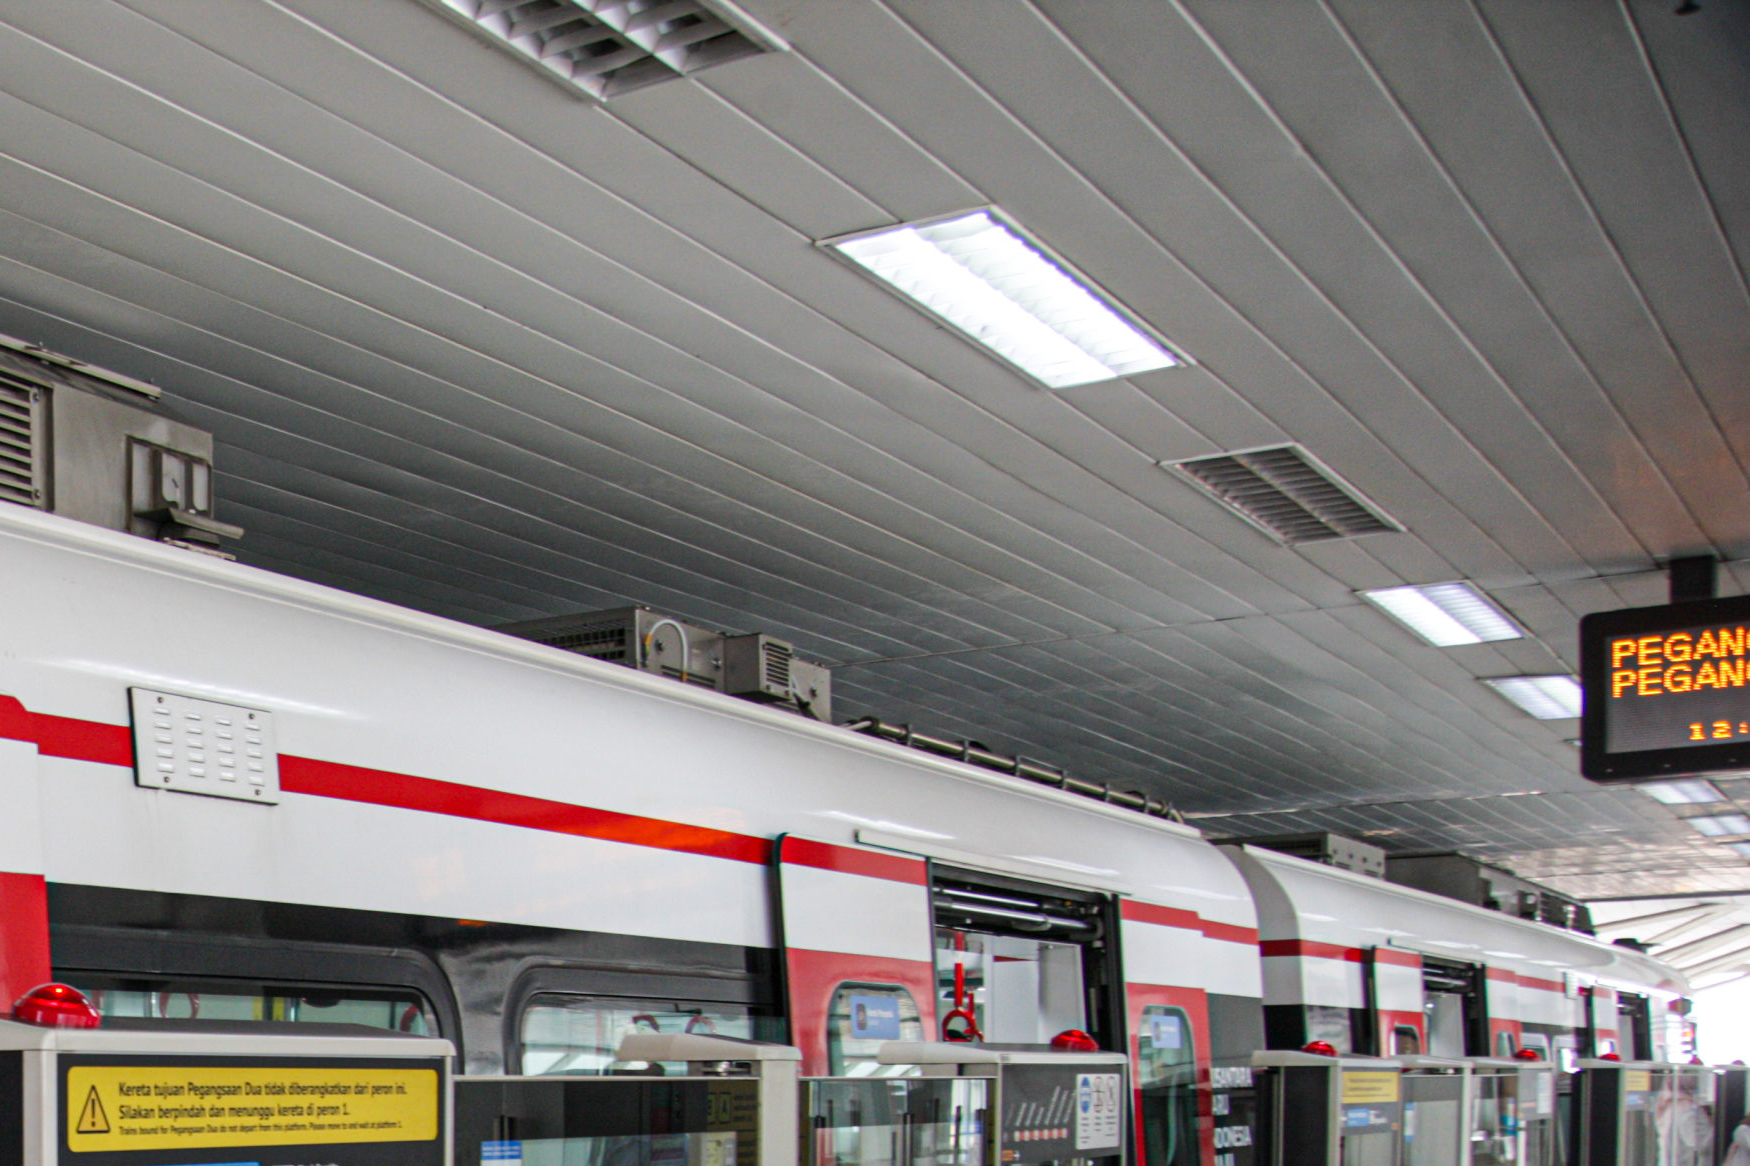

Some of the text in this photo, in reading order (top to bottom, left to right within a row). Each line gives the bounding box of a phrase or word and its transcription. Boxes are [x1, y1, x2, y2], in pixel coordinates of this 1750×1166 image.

[1612, 626, 1750, 668] PEGAN
[1612, 658, 1750, 698] PEGAN
[119, 1082, 150, 1096] Kereta
[154, 1083, 185, 1099] tujuan
[188, 1083, 242, 1099] Pegangsaan
[245, 1083, 262, 1095] Dua
[265, 1082, 285, 1095] tidak
[288, 1083, 351, 1098] diberangkatkan
[354, 1083, 370, 1095] dari
[372, 1084, 393, 1098] peron
[119, 1105, 154, 1119] Silakan
[158, 1104, 205, 1121] berpindah
[209, 1104, 225, 1117] dan
[229, 1106, 274, 1120] menunggu
[278, 1104, 303, 1117] kereta
[307, 1103, 314, 1116] di
[317, 1106, 340, 1118] peron
[119, 1126, 137, 1135] Trains
[140, 1126, 158, 1134] bound
[160, 1125, 168, 1134] for
[171, 1125, 205, 1136] Pegangsaan
[207, 1124, 217, 1133] Dua
